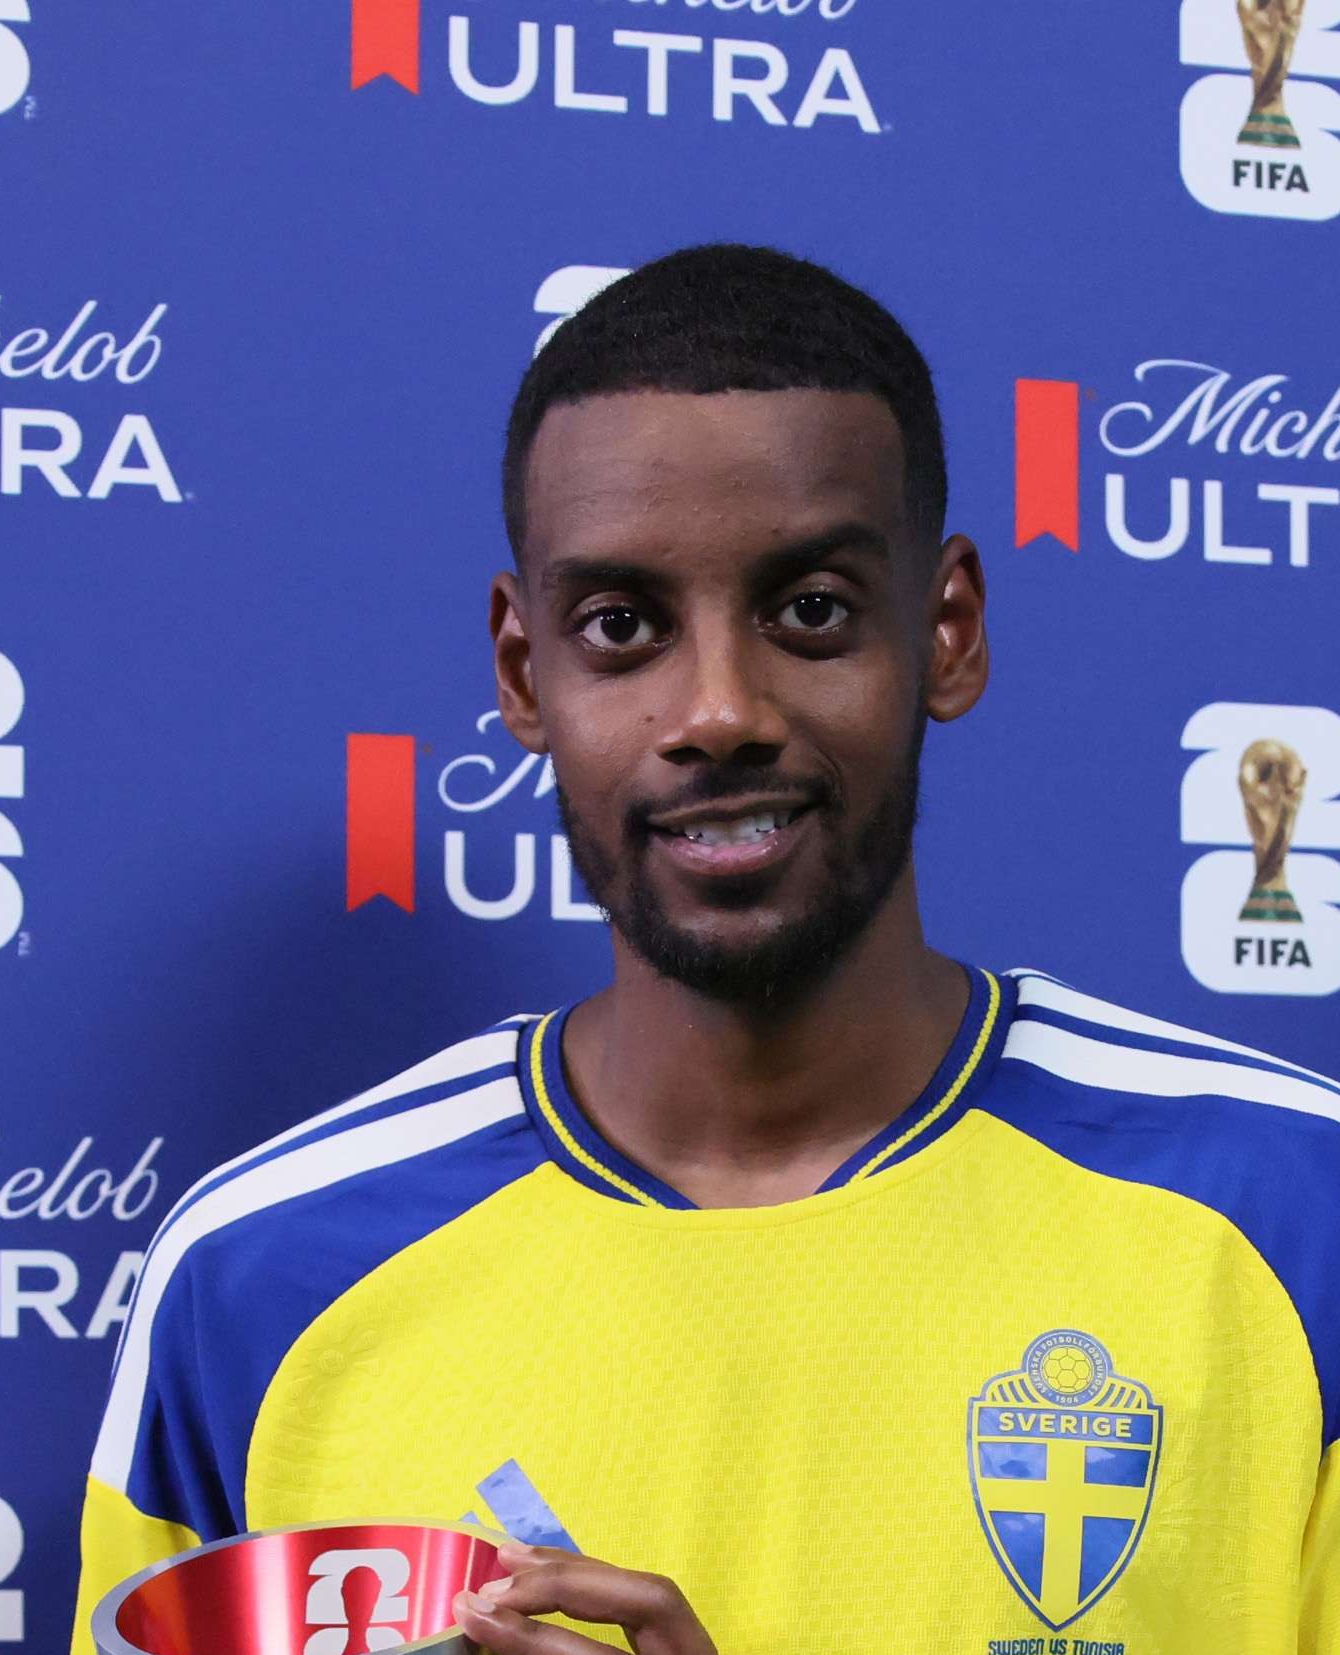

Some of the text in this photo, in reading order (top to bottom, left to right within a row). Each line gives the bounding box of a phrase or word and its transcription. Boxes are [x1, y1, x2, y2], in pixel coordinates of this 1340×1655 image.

[448, 9, 881, 134] ULTRA
[1233, 159, 1309, 193] FIFA
[1235, 938, 1311, 968] FIFA
[997, 1411, 1133, 1438] SVERIGE
